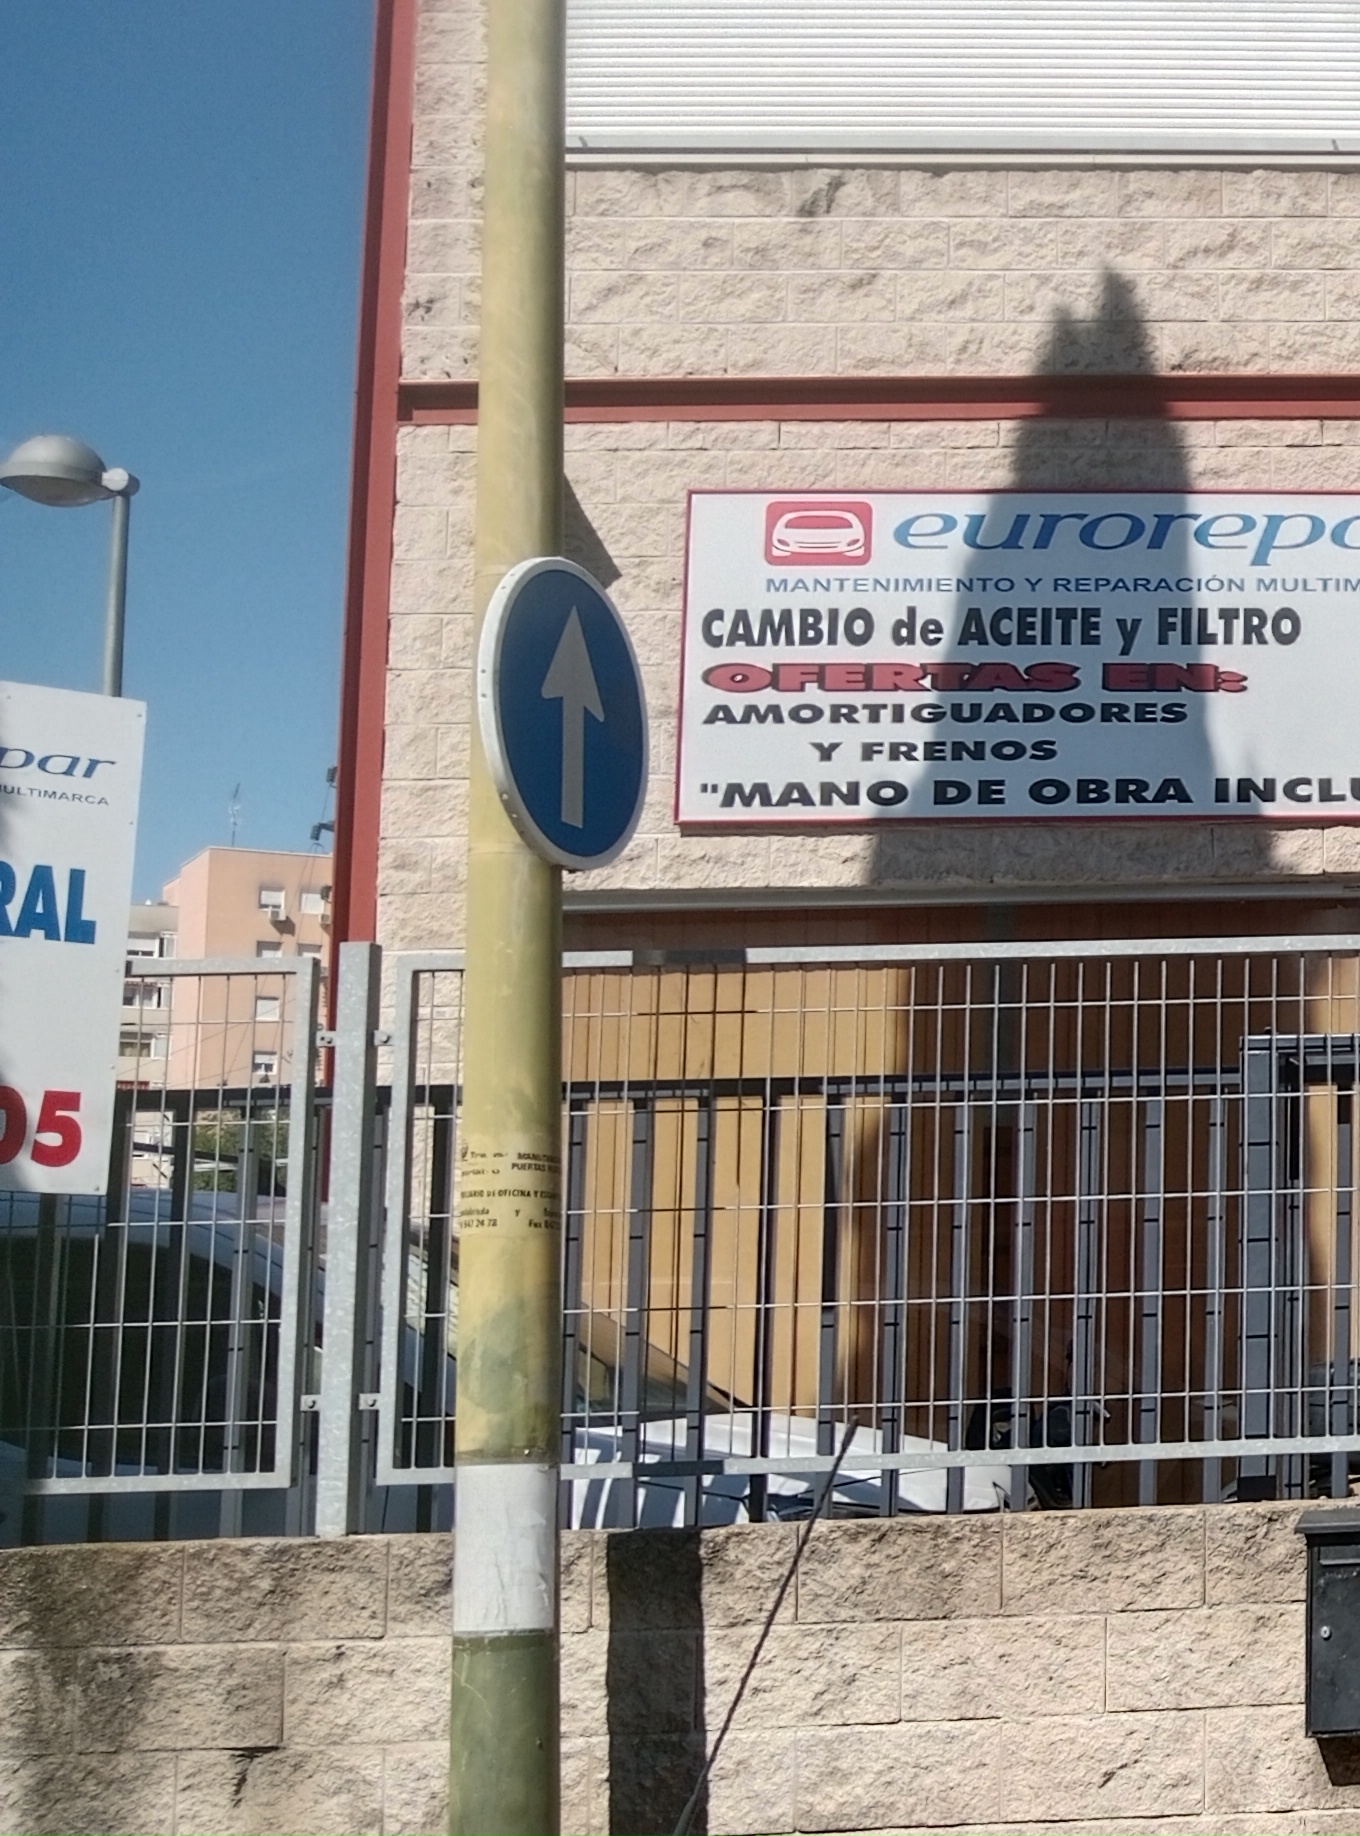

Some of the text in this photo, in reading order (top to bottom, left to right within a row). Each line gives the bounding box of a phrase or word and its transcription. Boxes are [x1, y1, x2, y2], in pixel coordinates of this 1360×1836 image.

[766, 577, 1015, 593] MANTENIMIENTO
[1024, 577, 1044, 592] Y
[1053, 574, 1245, 593] REPARACIÓN
[701, 605, 1302, 656] CAMBIO de ACEITE y FILTRO
[701, 662, 1248, 693] OFERTAS EN:
[703, 702, 1188, 726] AMORTIGUADORES
[810, 740, 1058, 762] Y FRENOS
[0, 784, 109, 806] ULTIMARCA
[700, 781, 909, 808] "MANO
[934, 780, 1006, 805] DE
[1028, 778, 1193, 805] OBRA
[498, 1189, 531, 1198] OFICINA
